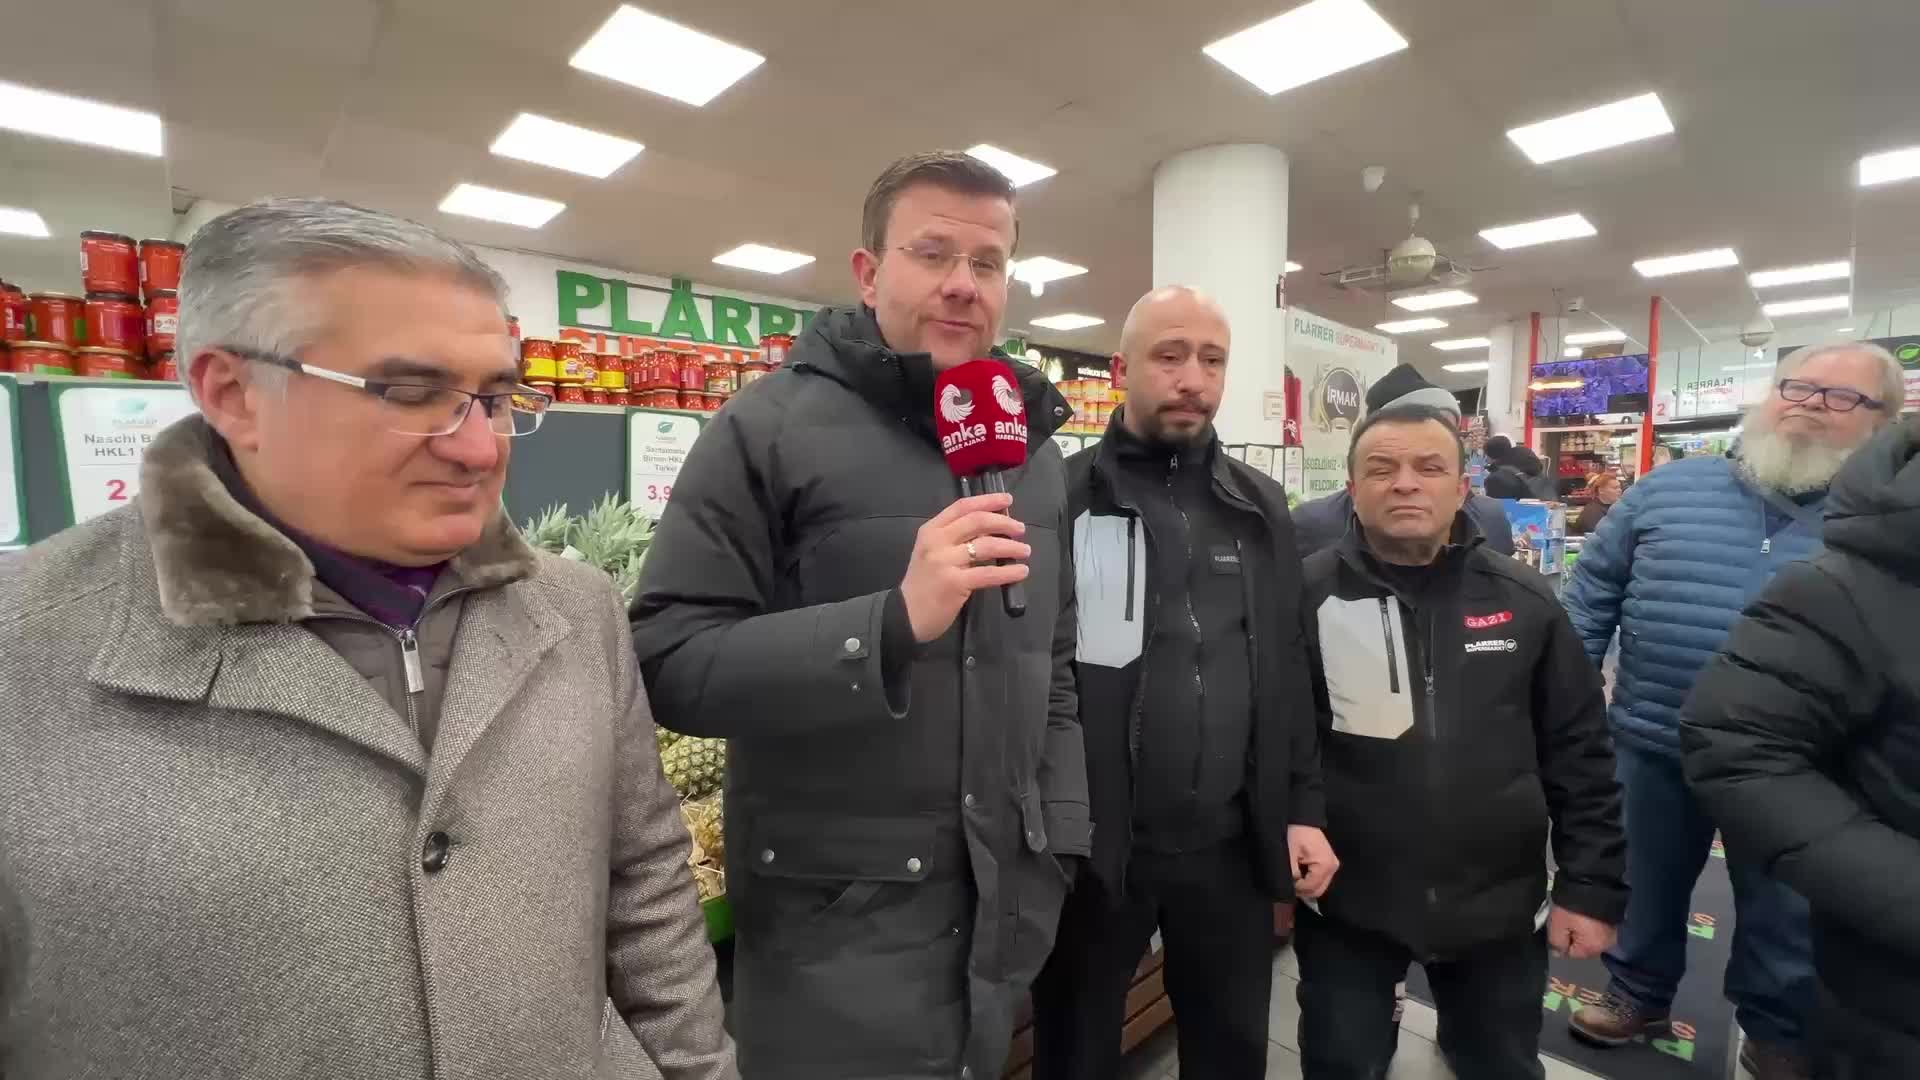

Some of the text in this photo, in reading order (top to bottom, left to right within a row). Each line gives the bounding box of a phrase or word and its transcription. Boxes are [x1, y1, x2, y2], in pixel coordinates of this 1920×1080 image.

[1326, 385, 1358, 413] IRMAK
[1655, 402, 1665, 416] 2
[943, 422, 987, 447] anka
[995, 417, 1027, 437] anka
[84, 433, 136, 444] Naschi
[95, 447, 134, 457] HKL1
